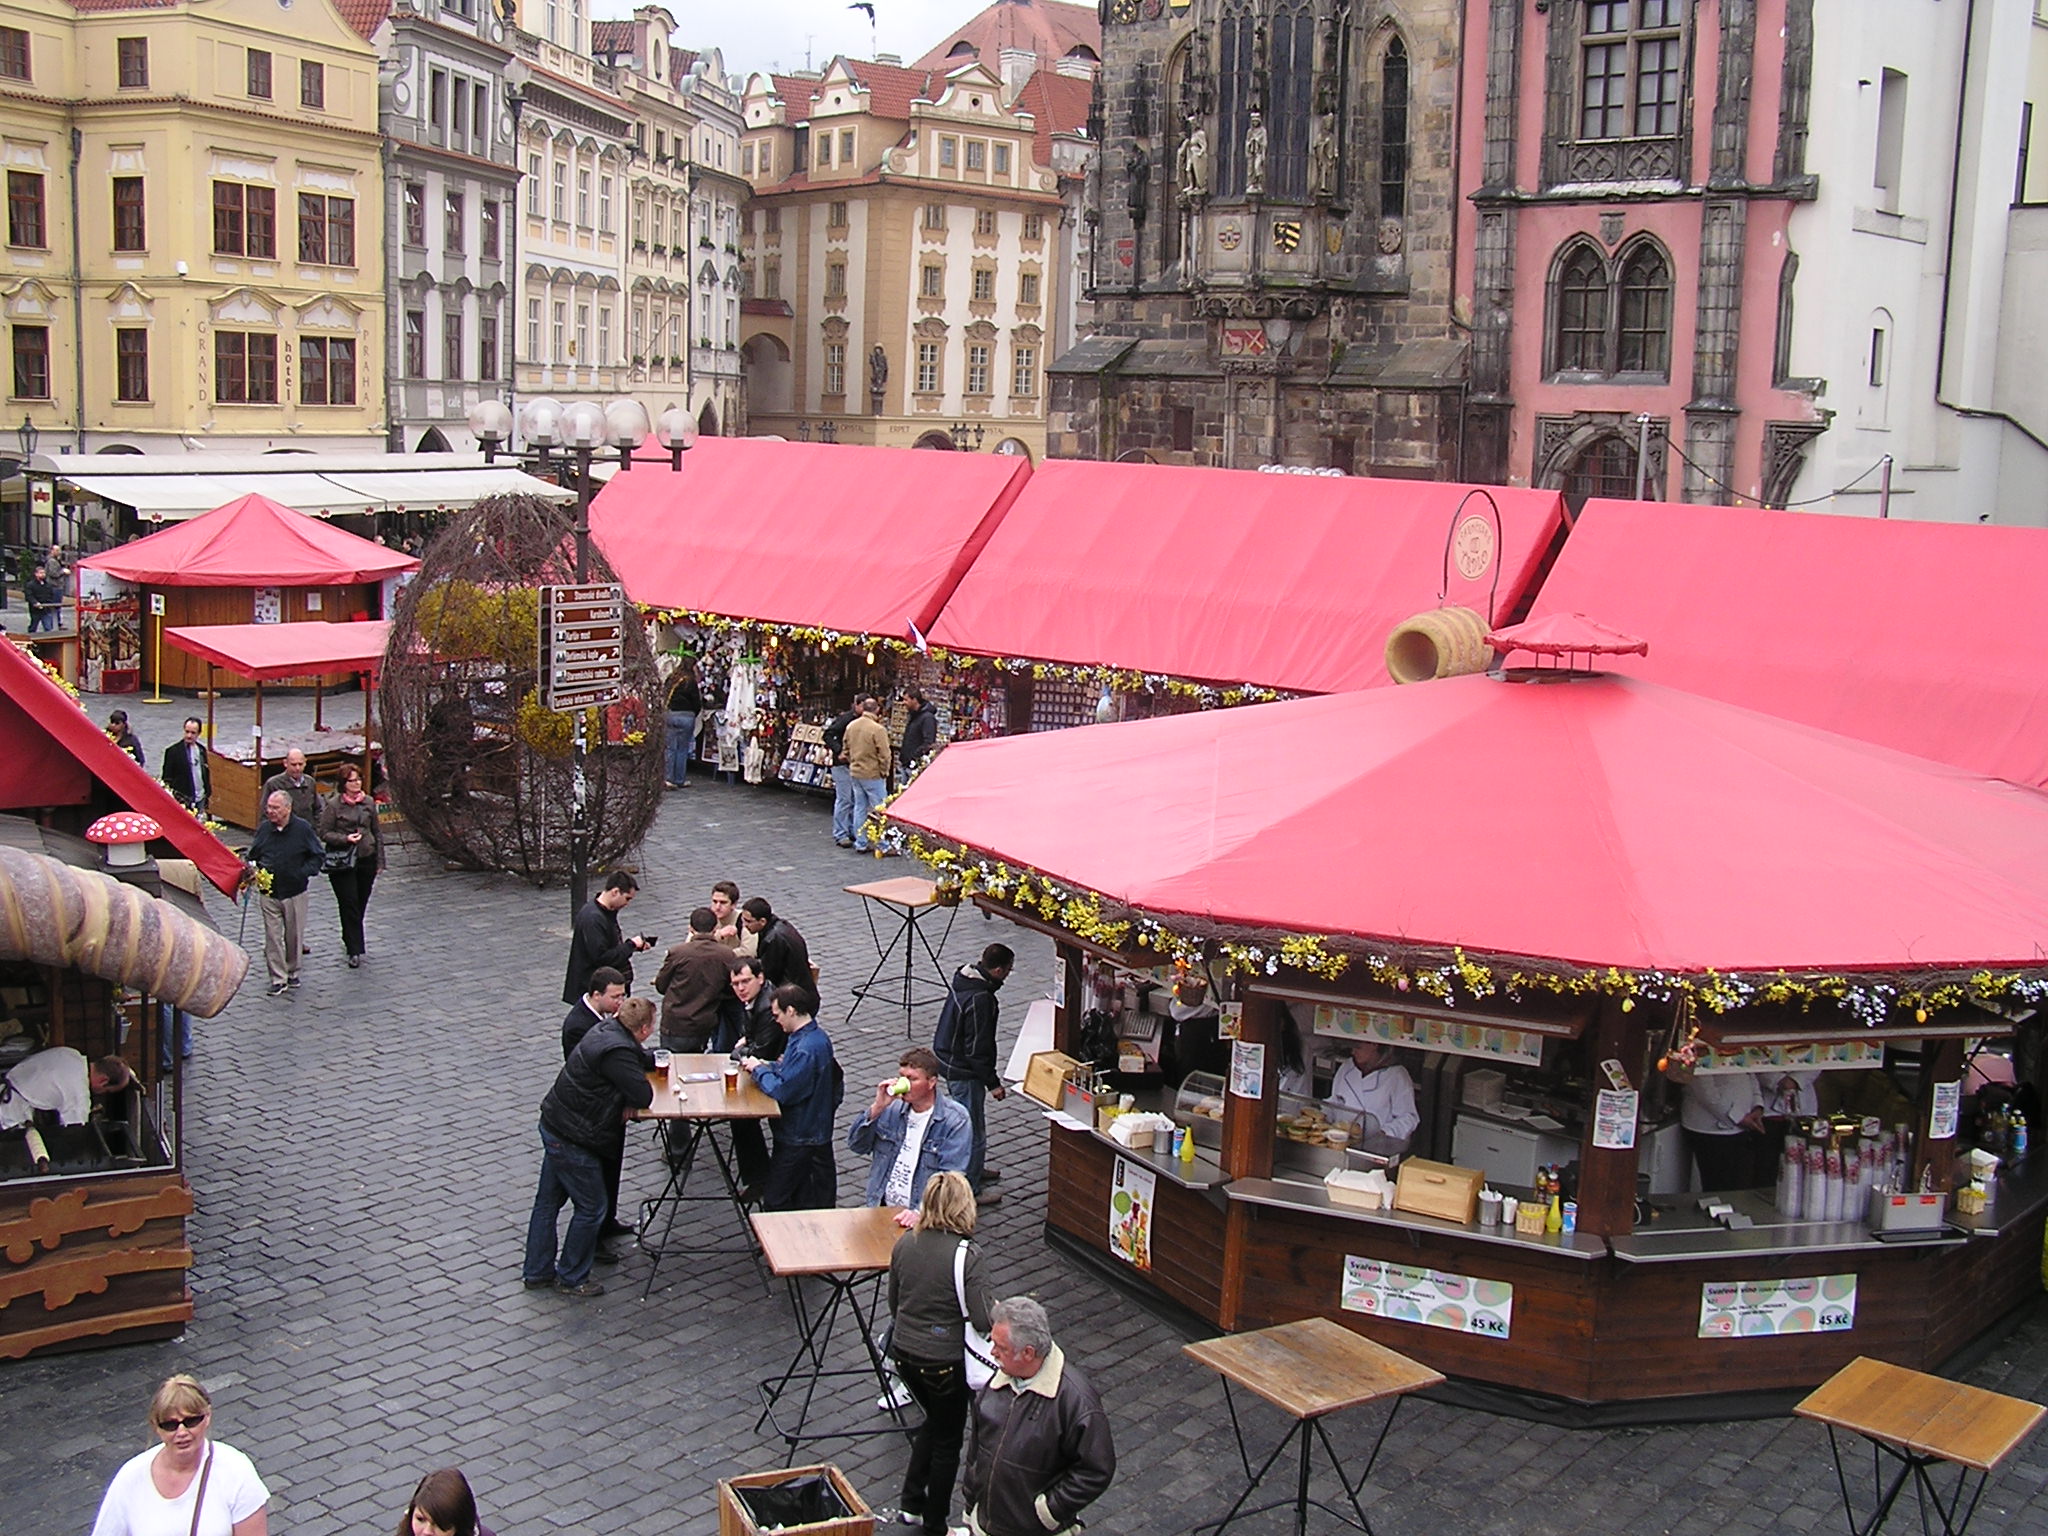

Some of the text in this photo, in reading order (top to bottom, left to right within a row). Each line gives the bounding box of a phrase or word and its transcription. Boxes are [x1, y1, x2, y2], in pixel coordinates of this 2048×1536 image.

[197, 321, 207, 401] GRAND
[284, 340, 293, 401] hotel
[362, 329, 370, 402] PRAHA
[1470, 1317, 1504, 1333] 45 Kč
[1819, 1313, 1849, 1326] 45 Kč
